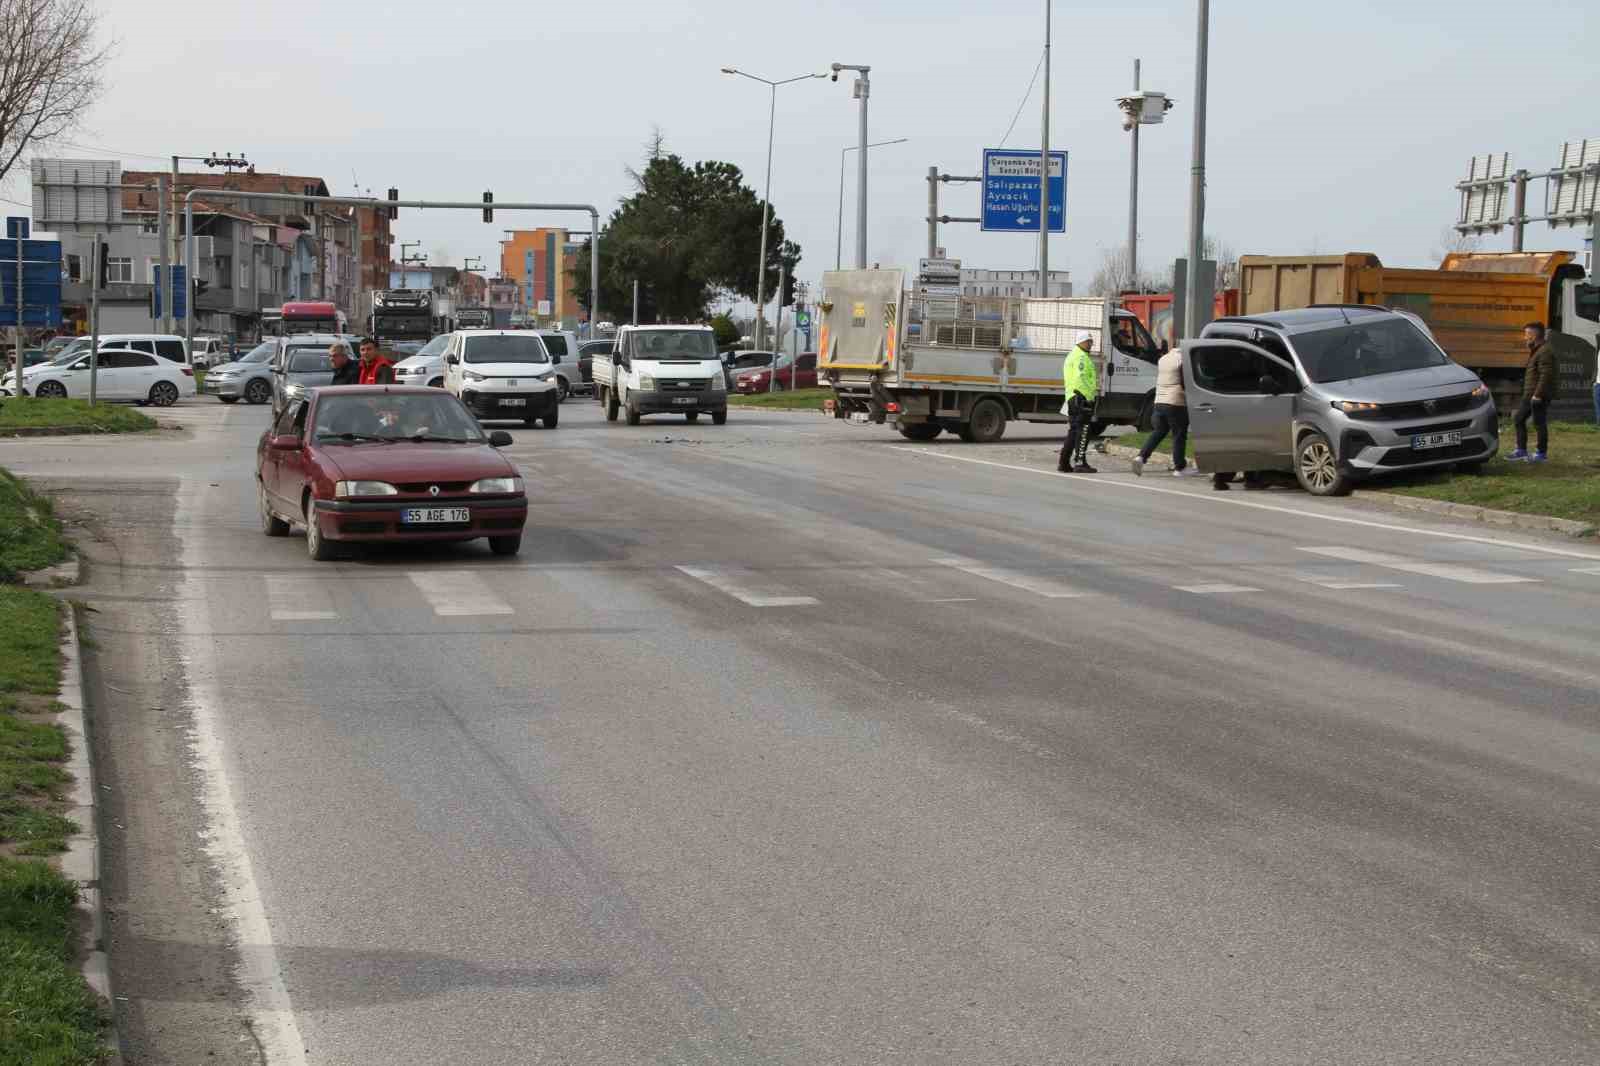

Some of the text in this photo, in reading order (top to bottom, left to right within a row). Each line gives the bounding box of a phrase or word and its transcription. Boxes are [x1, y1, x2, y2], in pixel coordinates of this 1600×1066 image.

[987, 192, 1029, 202] Ayvacık
[408, 510, 421, 521] 55
[450, 509, 468, 520] 176
